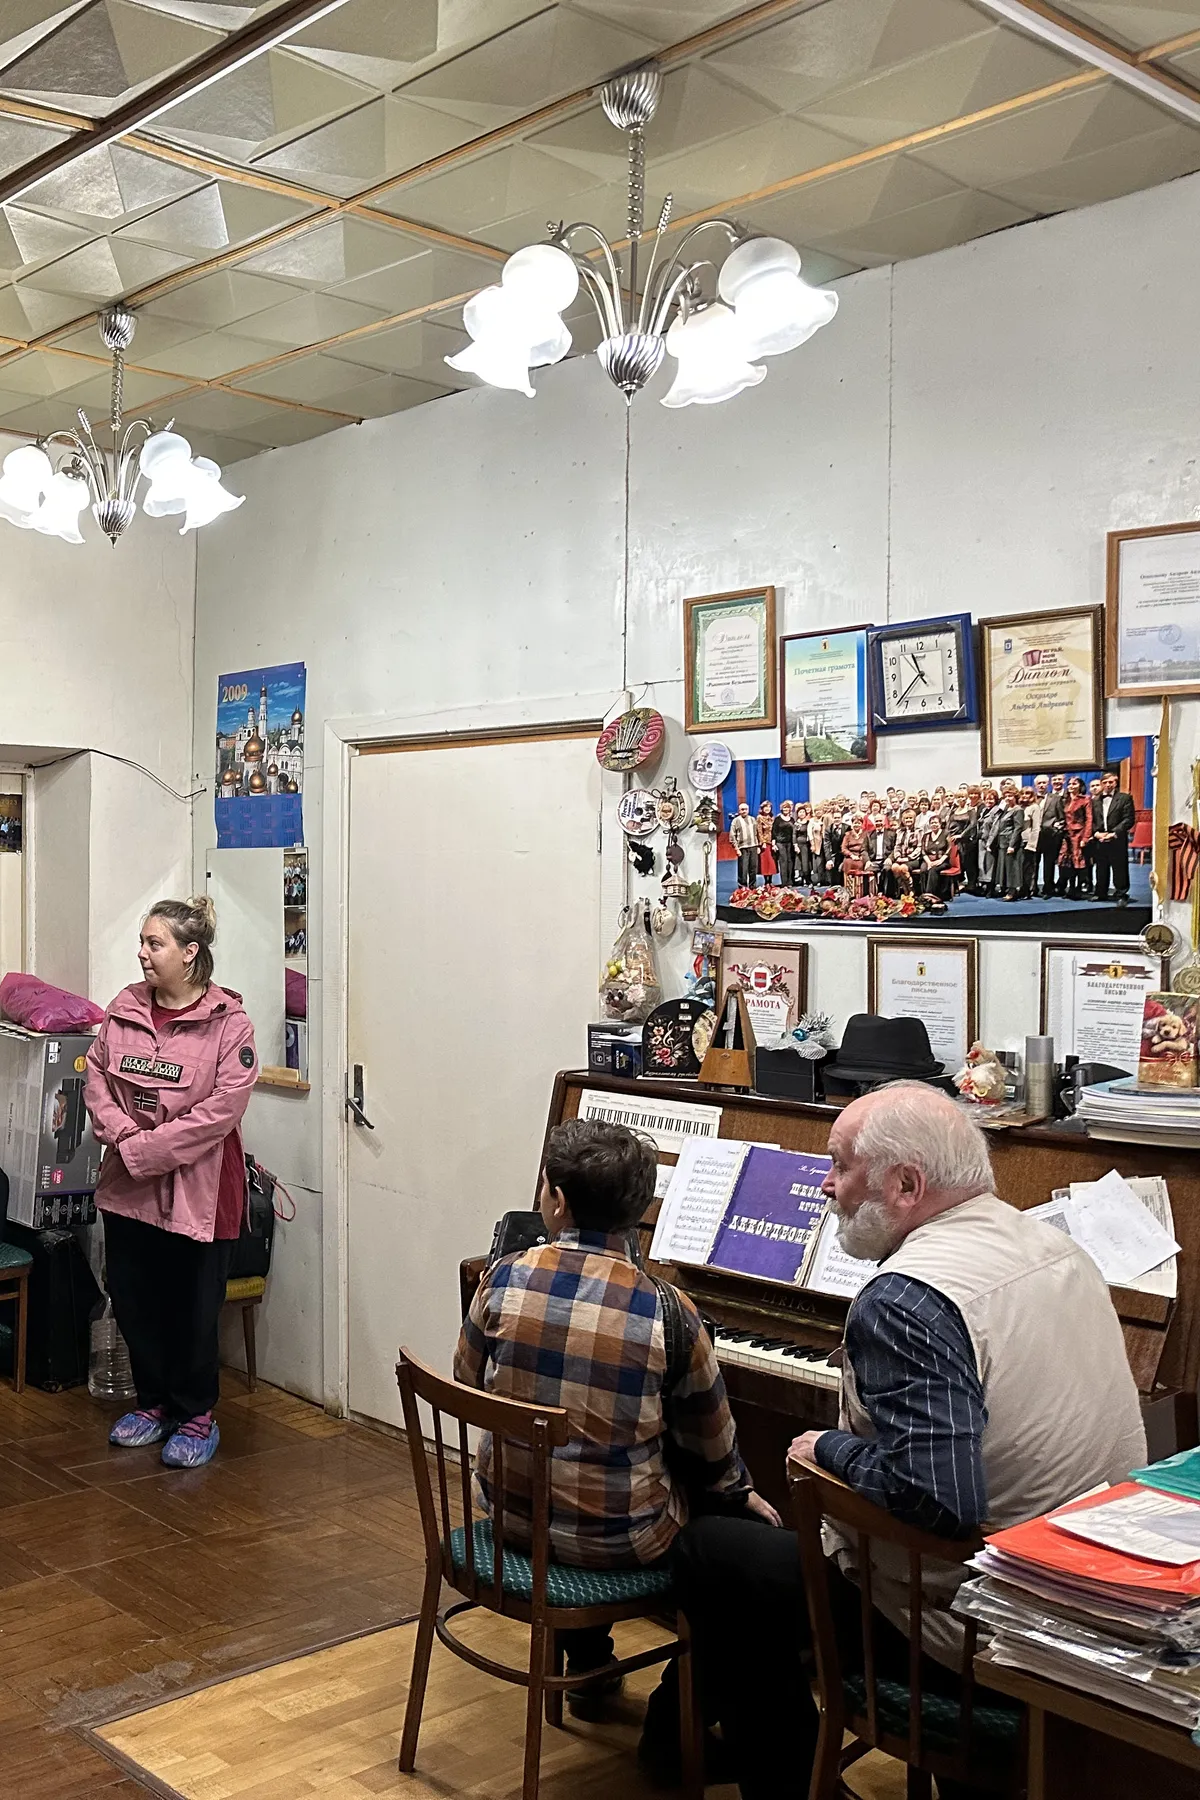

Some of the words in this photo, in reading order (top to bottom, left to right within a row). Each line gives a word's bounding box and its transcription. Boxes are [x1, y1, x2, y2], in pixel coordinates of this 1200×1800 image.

[916, 641, 924, 650] 12
[935, 639, 938, 648] 1
[900, 644, 906, 653] 11
[947, 649, 952, 658] 2
[889, 657, 897, 666] 10
[794, 666, 826, 676] Почетная
[827, 663, 855, 673] грамота
[948, 666, 953, 675] 3
[891, 673, 897, 682] 9
[1008, 667, 1073, 683] Диплом
[949, 684, 954, 692] 4
[222, 683, 248, 703] 2009
[892, 689, 898, 699] 8
[905, 700, 909, 709] 7
[921, 698, 927, 707] 6
[938, 696, 943, 705] 5
[891, 978, 958, 988] Благодарственное
[1087, 981, 1145, 990] БЛАГОДАРСТВЕННОЕ
[745, 998, 781, 1009] РАМОТА
[761, 1292, 816, 1313] LIRIKA
